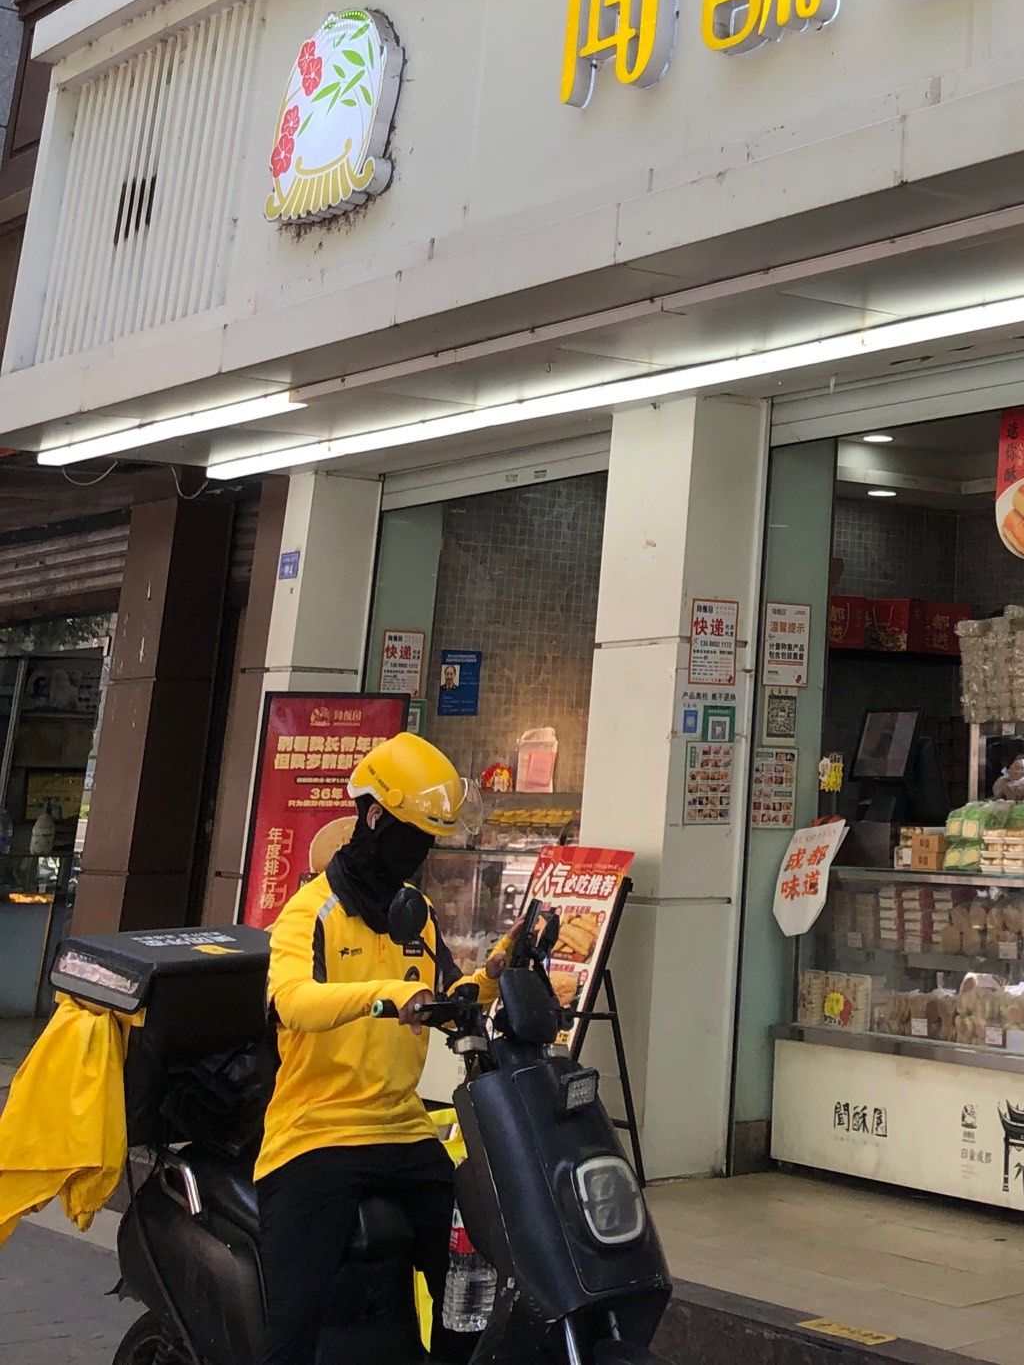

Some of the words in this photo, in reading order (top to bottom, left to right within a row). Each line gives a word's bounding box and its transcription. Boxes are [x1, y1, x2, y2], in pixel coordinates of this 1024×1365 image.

[693, 617, 724, 636] 快递
[770, 621, 805, 634] 温馨提示
[385, 644, 412, 660] 快递
[769, 643, 805, 652] 计量称重产品
[310, 788, 344, 800] 36年
[784, 844, 829, 872] 成都
[261, 827, 283, 909] 年度排行榜
[533, 862, 617, 895] 人气必吃推荐
[780, 869, 821, 900] 味道
